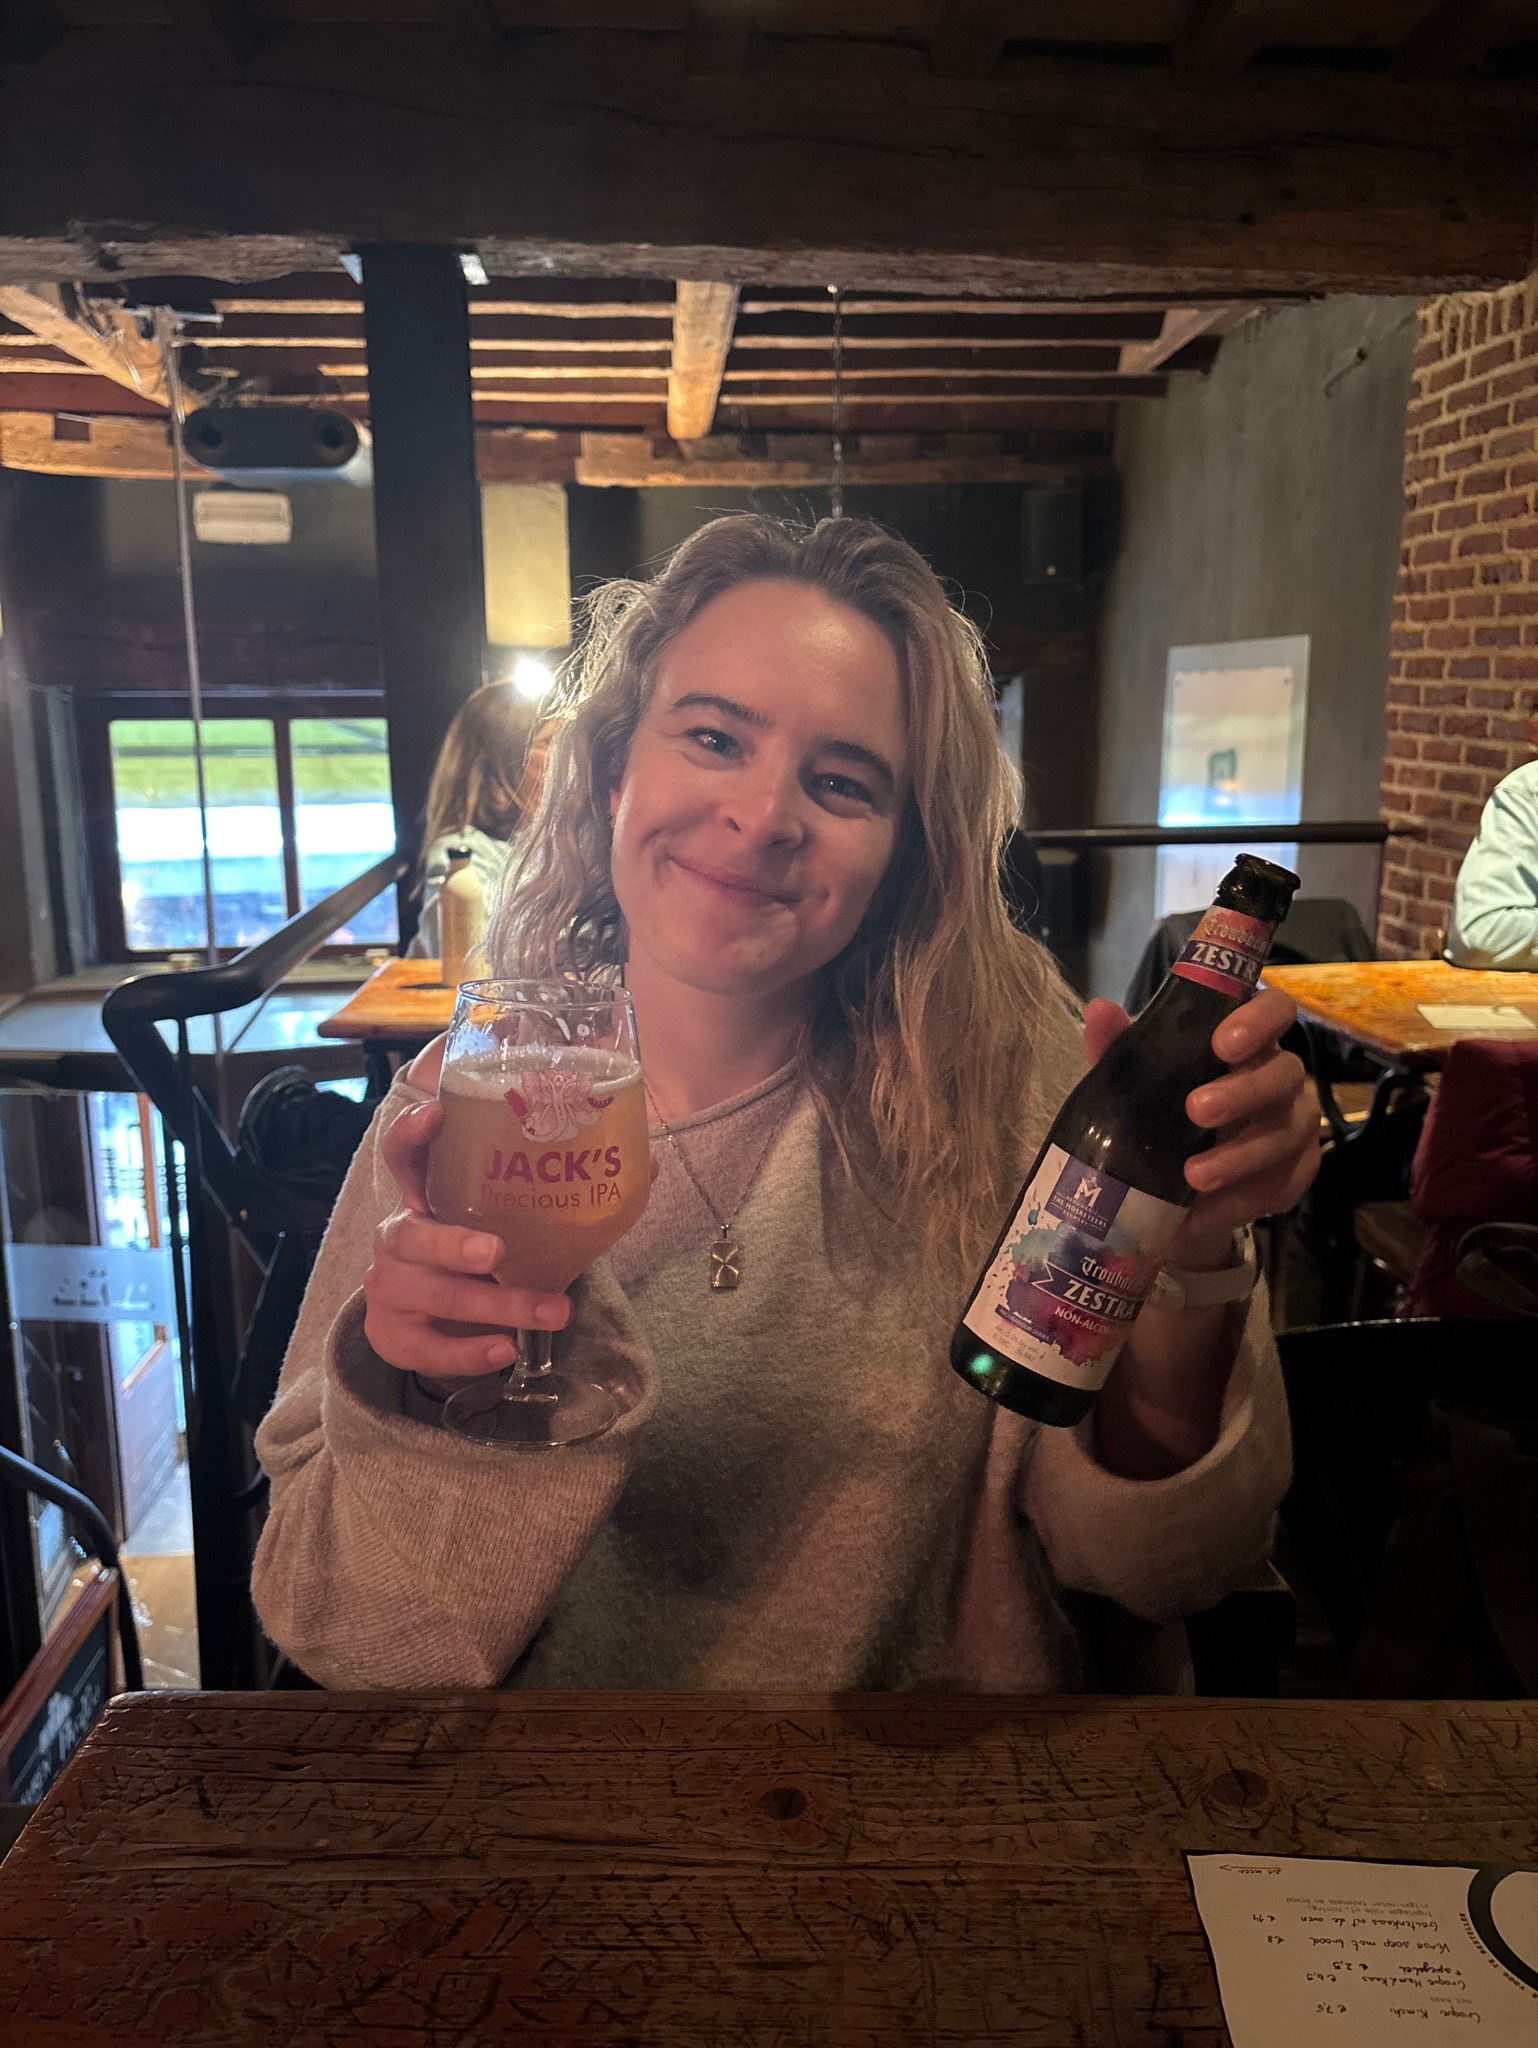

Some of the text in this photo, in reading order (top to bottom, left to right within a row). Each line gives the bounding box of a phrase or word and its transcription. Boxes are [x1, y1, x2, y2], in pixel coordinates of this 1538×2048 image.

[1191, 942, 1258, 980] ZESTR
[484, 1145, 621, 1183] JACK'S
[481, 1181, 622, 1208] Precious IPA
[1073, 1178, 1102, 1208] M
[1053, 1194, 1107, 1228] THE MUSKETEERS
[1063, 1279, 1136, 1320] ZESTRA
[1331, 1917, 1346, 1927] de
[1352, 1918, 1366, 1928] uit
[1371, 1919, 1438, 1932] Geitenkaas
[1308, 1937, 1344, 1949] brood
[1351, 1940, 1376, 1951] met
[1383, 1938, 1410, 1949] soep
[1416, 1942, 1450, 1954] Verse
[1332, 1960, 1353, 1971] 2,5
[1398, 1961, 1452, 1976] spiegelei
[1428, 1975, 1466, 1990] Croque
[1390, 2008, 1428, 2019] Kimchi
[1440, 2006, 1481, 2024] Croque
